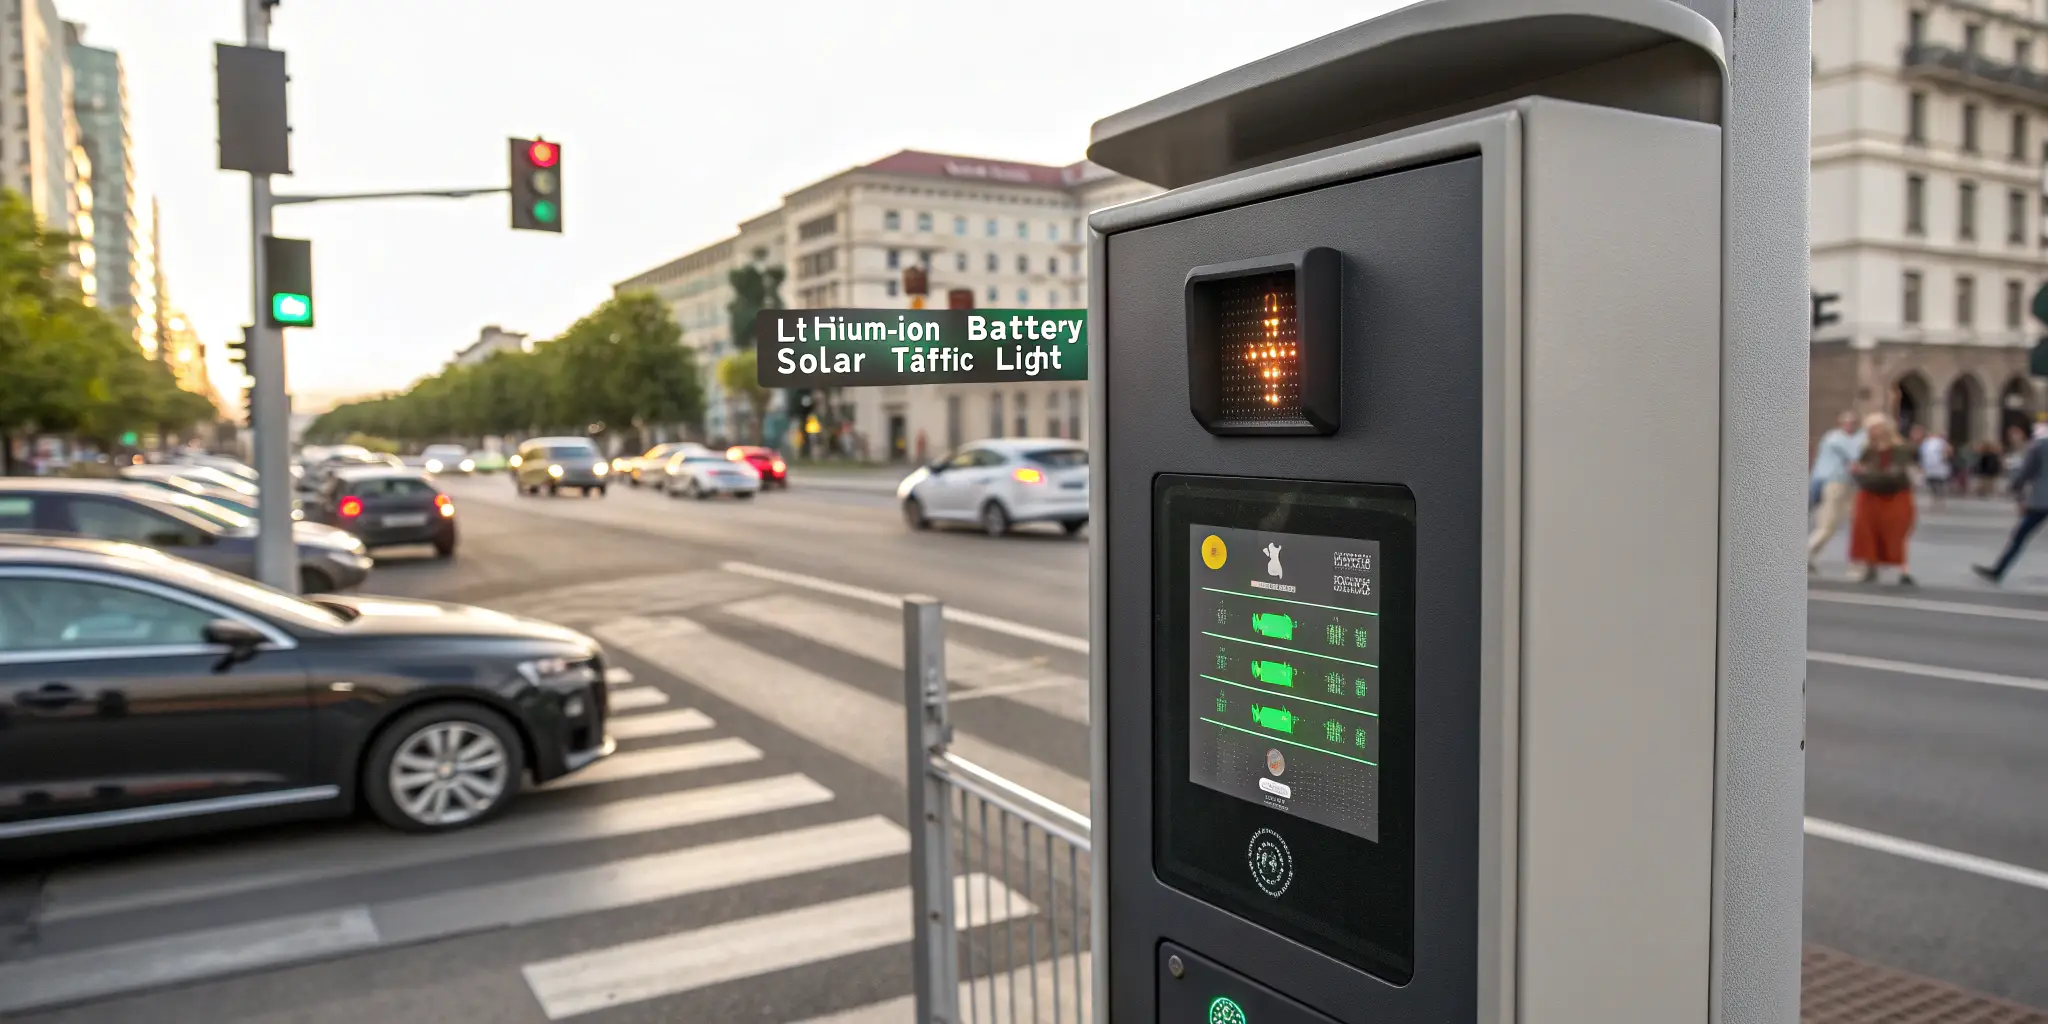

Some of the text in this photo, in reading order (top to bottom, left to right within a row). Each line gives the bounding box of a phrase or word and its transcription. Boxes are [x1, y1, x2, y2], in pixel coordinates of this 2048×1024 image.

[967, 315, 1083, 344] Battery
[777, 345, 866, 375] Solar
[996, 344, 1062, 376] Light
